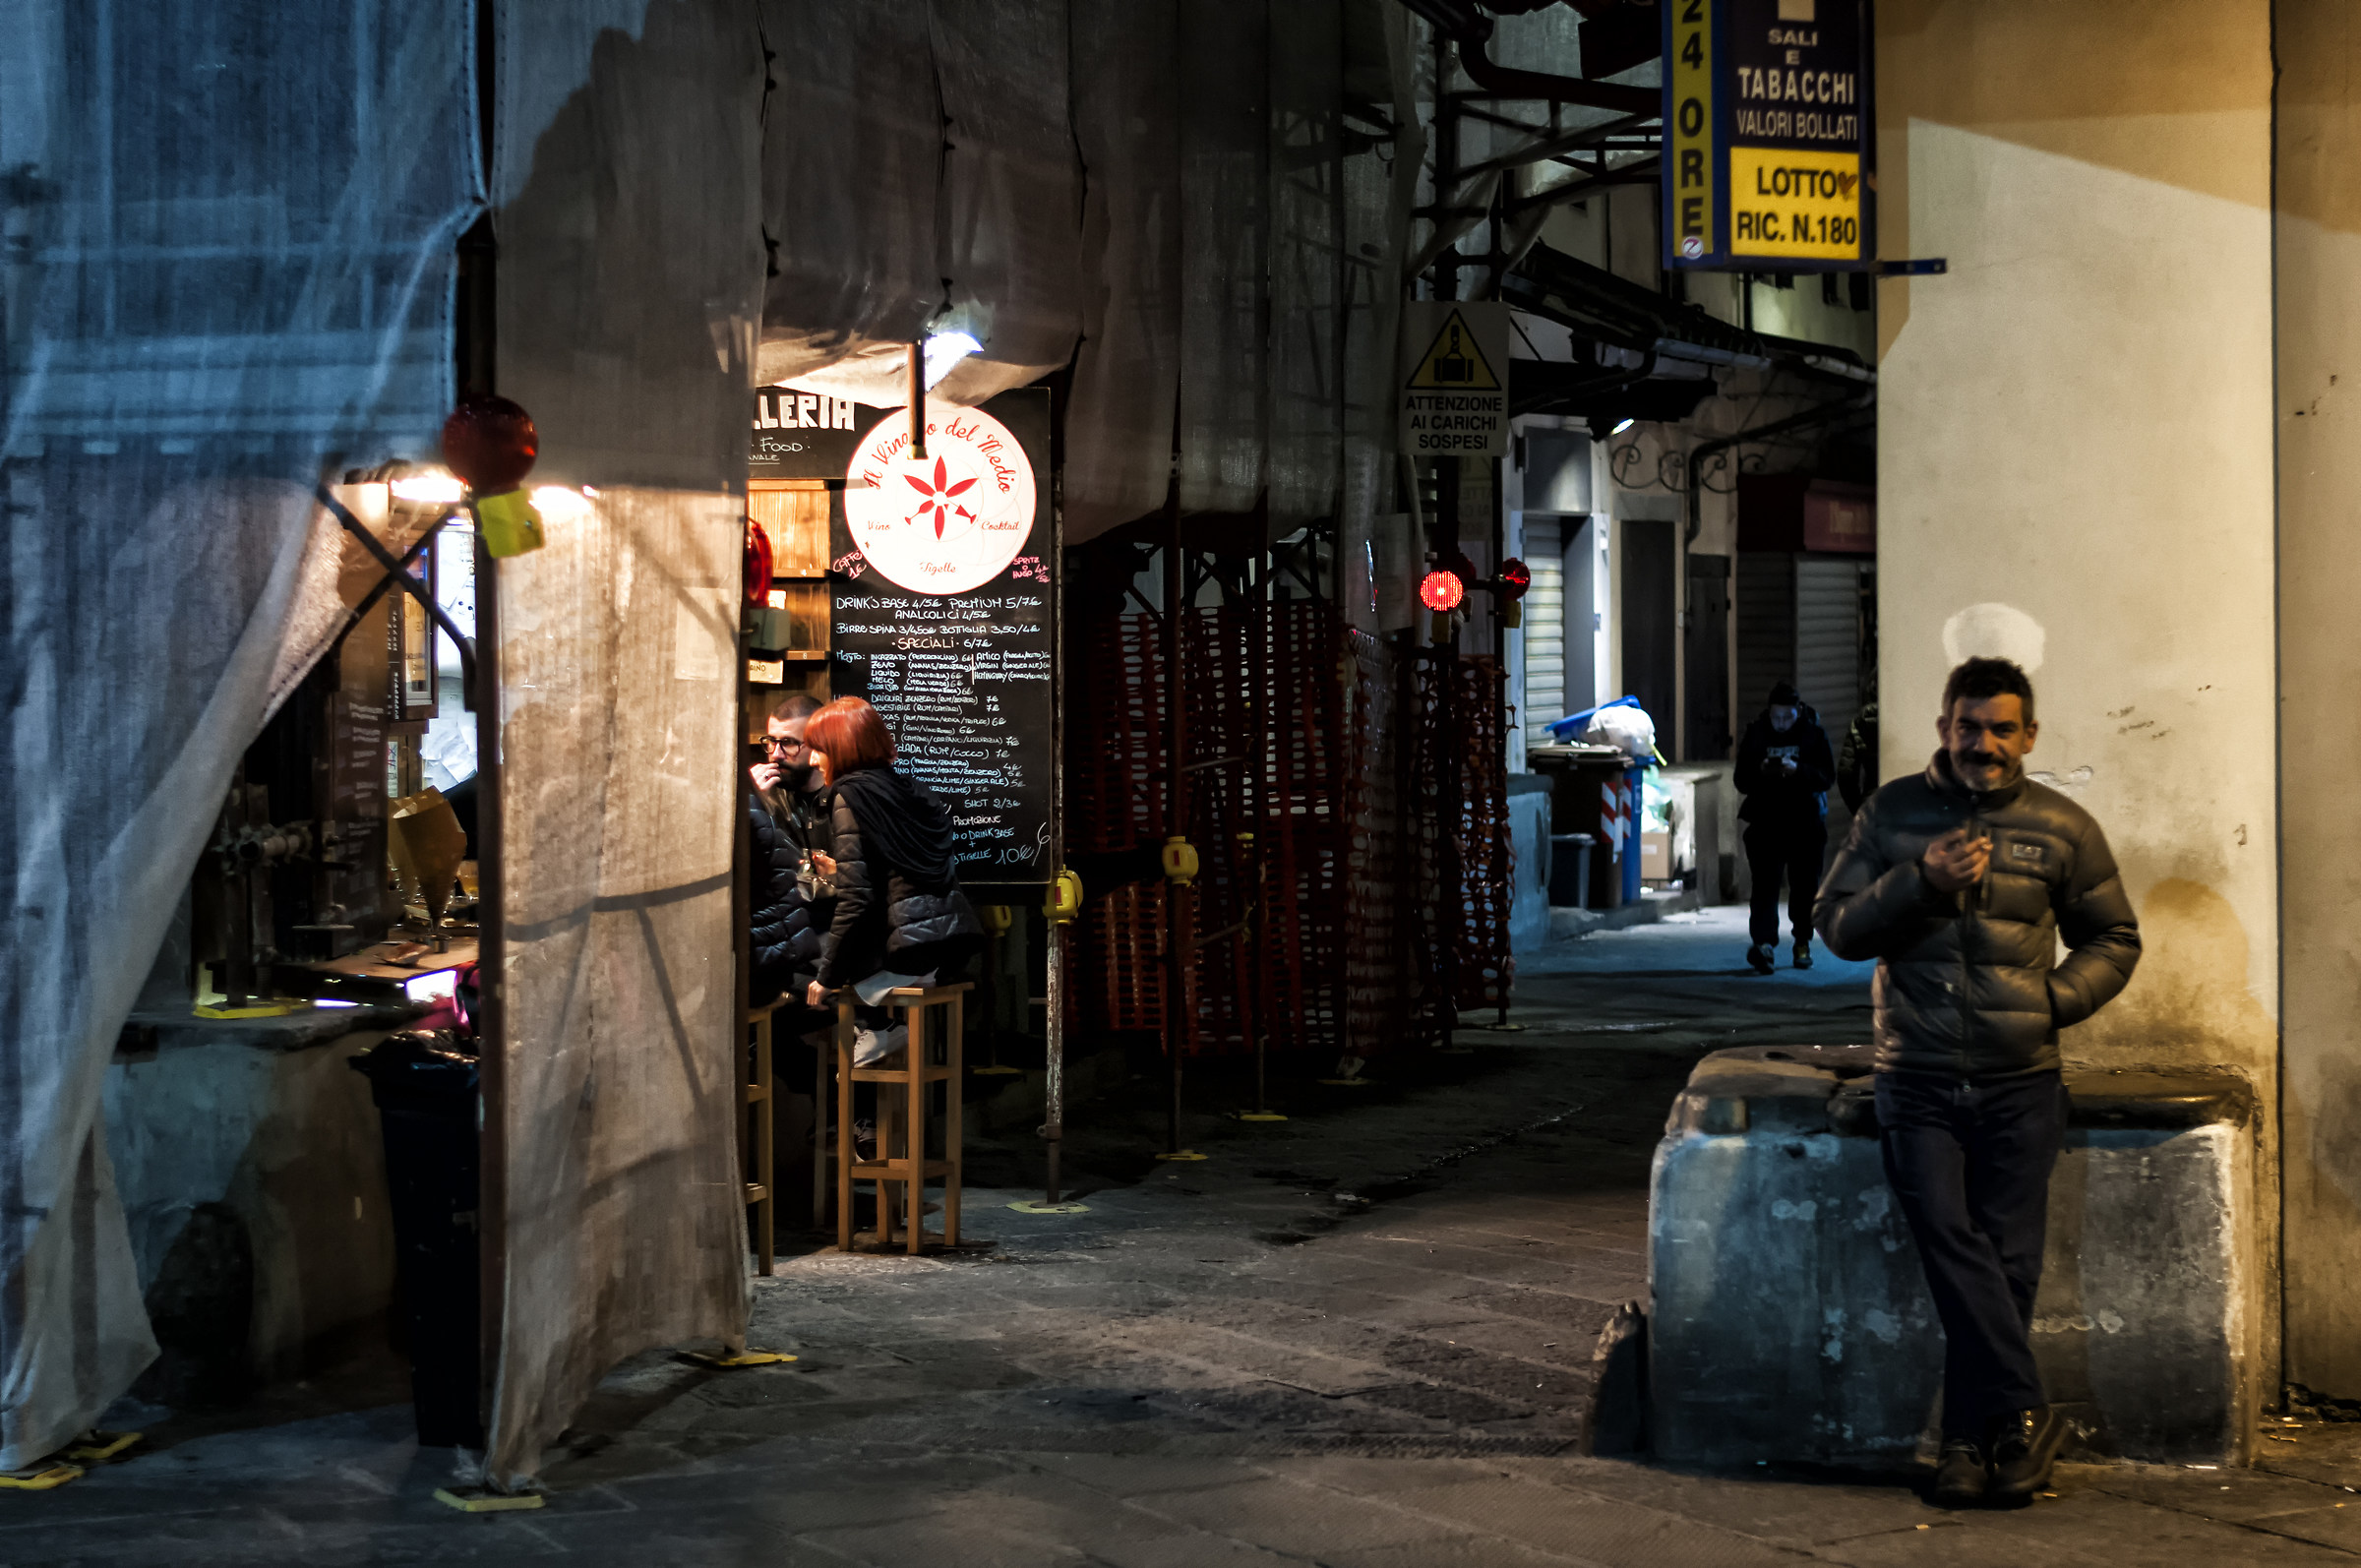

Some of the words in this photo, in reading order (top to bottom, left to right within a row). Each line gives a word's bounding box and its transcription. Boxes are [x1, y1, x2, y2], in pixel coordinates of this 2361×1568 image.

[1681, 0, 1703, 70] 24
[1768, 30, 1818, 46] SALI
[1786, 49, 1799, 65] E
[1737, 67, 1854, 104] TABACCHI
[1737, 109, 1791, 137] VALORI
[1796, 113, 1857, 140] BOLLATI
[1679, 97, 1704, 237] ORE
[1757, 166, 1837, 198] LOTTO
[1737, 211, 1786, 242] RIC.
[1792, 213, 1856, 245] N.180
[1406, 396, 1502, 411] ATTENZIONE
[753, 394, 856, 432] LERIA
[1411, 415, 1425, 430] AI
[1431, 415, 1496, 431] CARICHI
[1419, 434, 1487, 449] SOSPESI
[945, 417, 980, 442] del
[978, 434, 1016, 494] Medio
[868, 520, 890, 530] Vino
[981, 520, 1020, 531] Cocktail
[919, 562, 956, 575] Tigelle
[881, 597, 909, 609] BASE
[895, 609, 959, 620] ANALCOLICI
[870, 624, 896, 634] SPINA
[964, 798, 989, 809] SHOT
